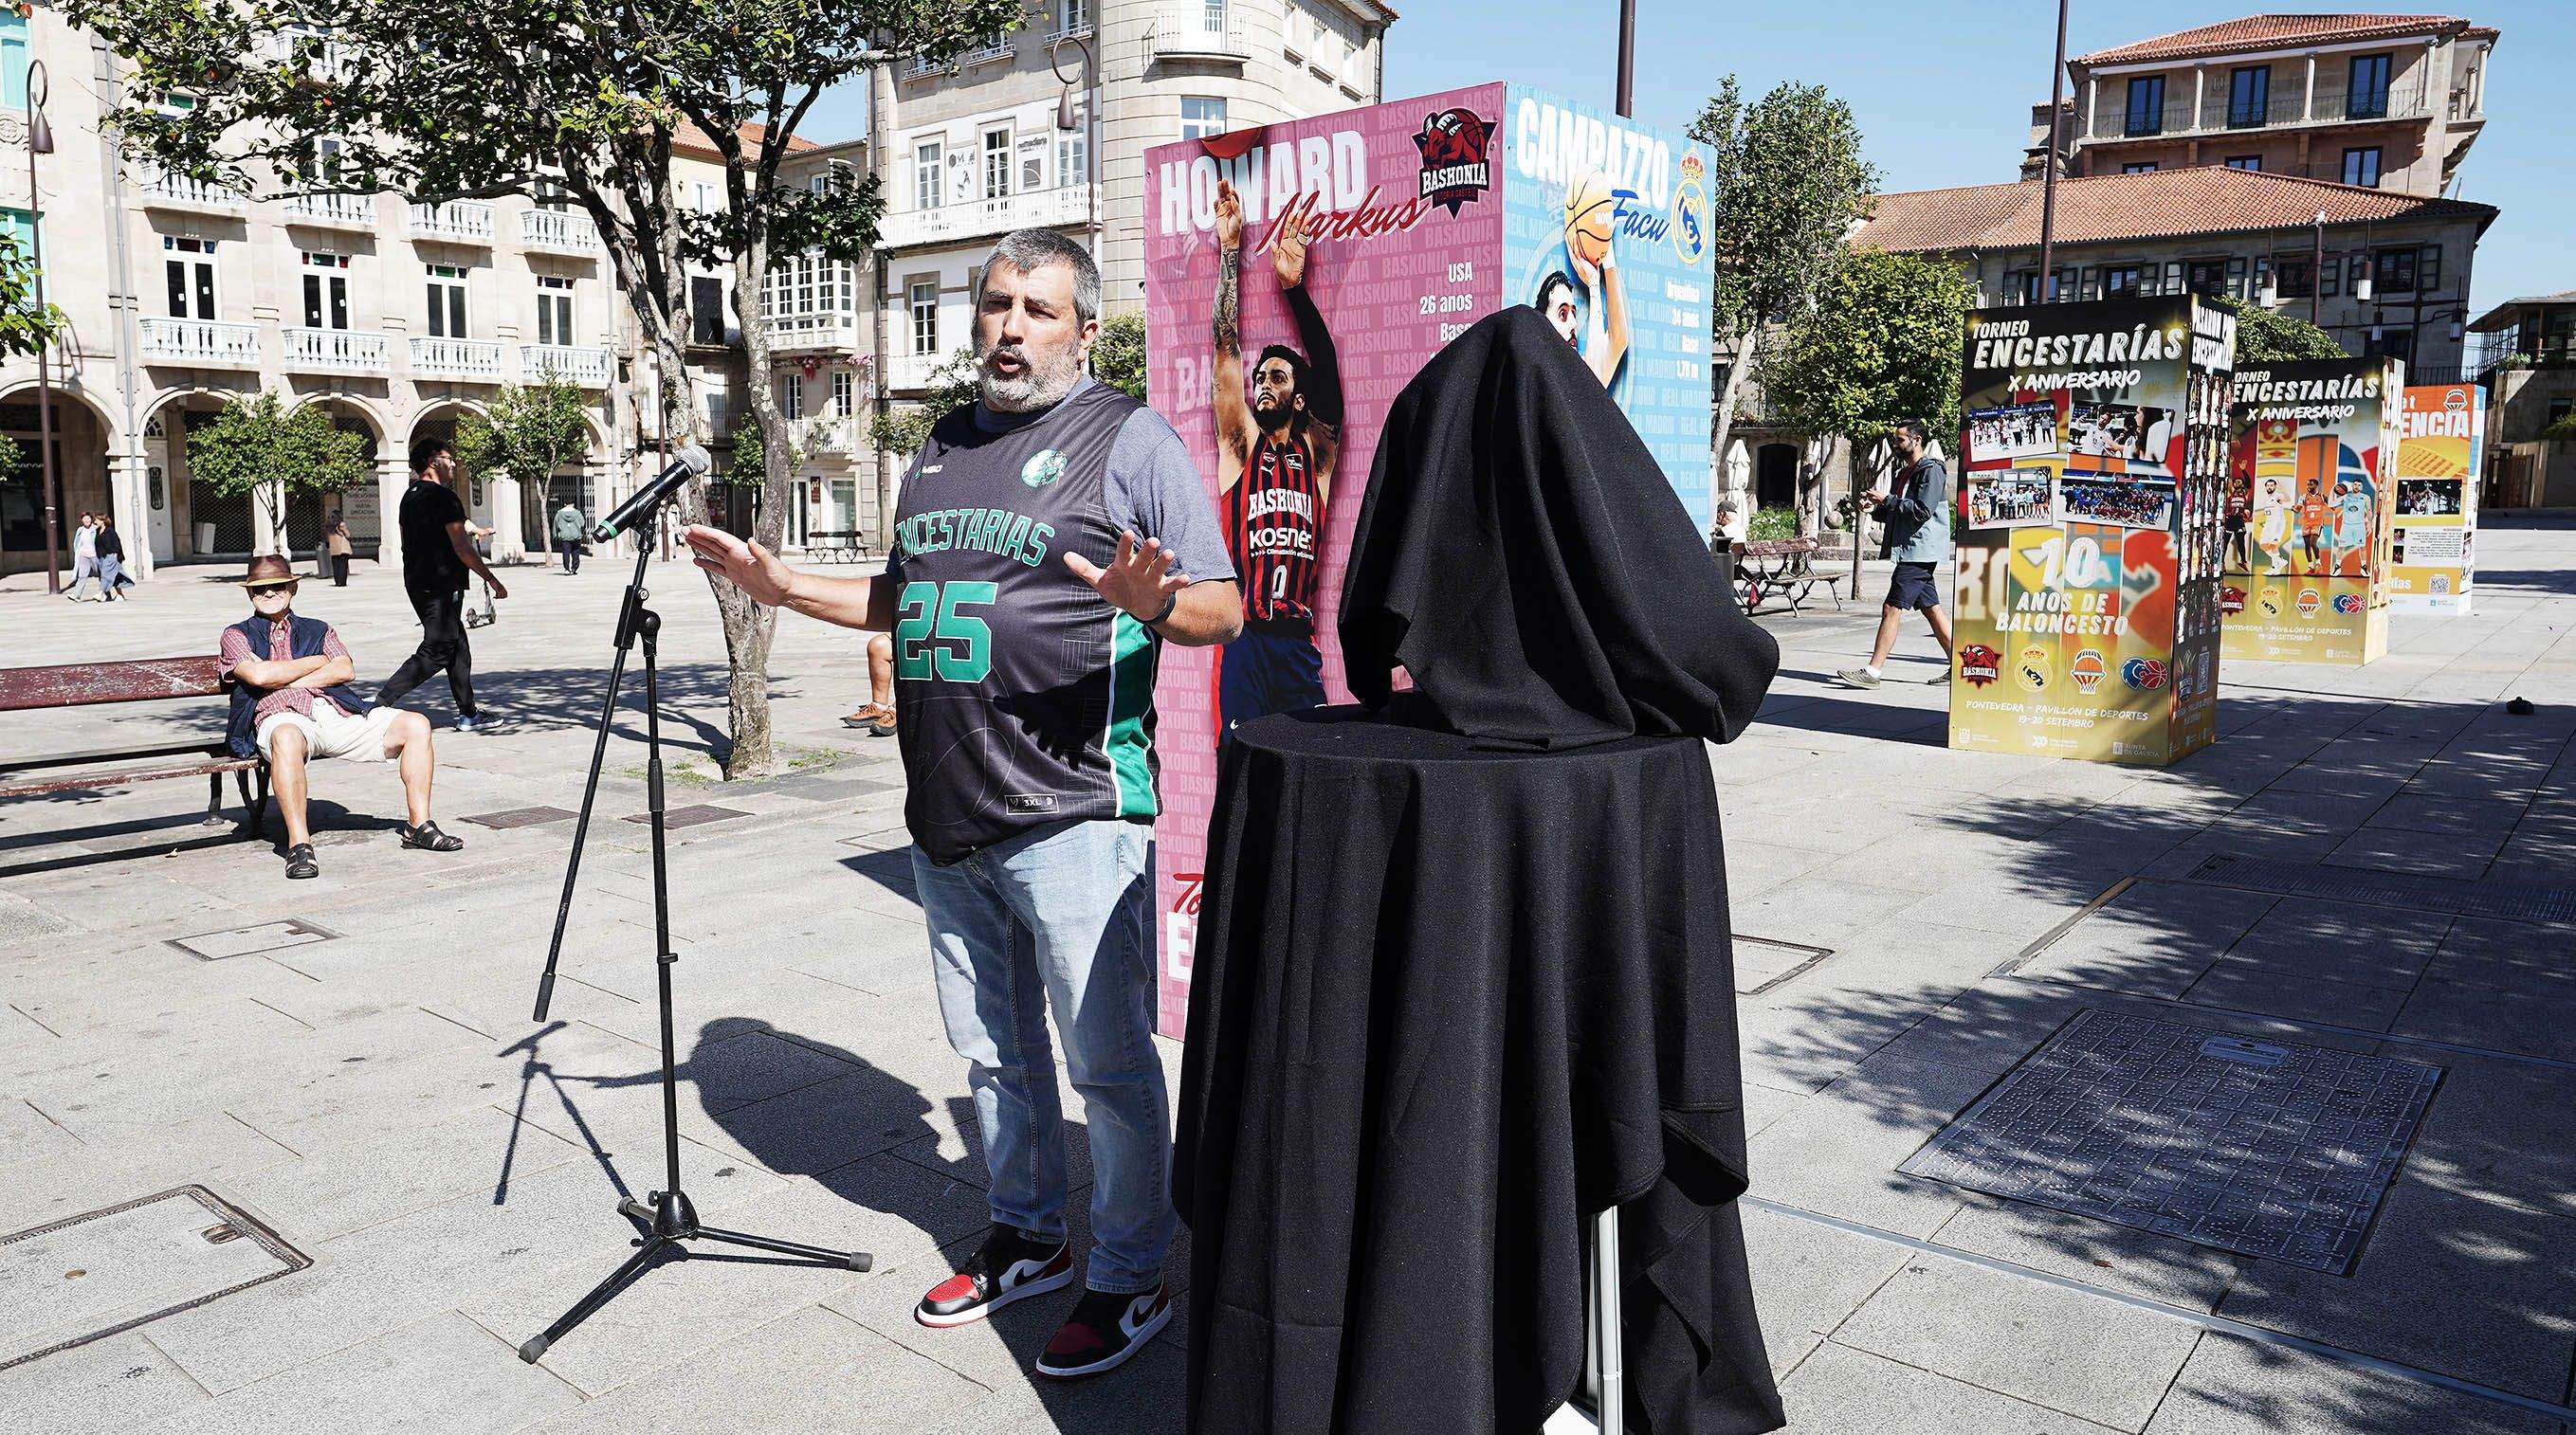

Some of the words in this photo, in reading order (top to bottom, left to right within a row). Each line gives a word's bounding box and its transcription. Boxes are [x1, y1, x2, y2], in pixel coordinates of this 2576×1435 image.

[1517, 97, 1670, 211] CAMPAZZO
[1160, 131, 1365, 236] HOWARD
[1422, 162, 1488, 194] BASKONIA
[1254, 185, 1433, 255] Markus
[1611, 189, 1670, 243] Facu
[1448, 262, 1472, 282] USA
[1419, 296, 1436, 316] 26
[1440, 294, 1472, 313] anos
[1972, 319, 2030, 339] TORNEO
[1973, 323, 2185, 370] ENCESTARÍAS
[2006, 374, 2022, 392] X
[2024, 369, 2142, 392] ANIVERSARIO
[2233, 373, 2380, 404] ENCESTARÍAS
[2234, 371, 2271, 384] ORNEO
[2246, 408, 2259, 422] X
[2260, 405, 2355, 421] ANIVERSARIO
[1248, 487, 1312, 525] BASKONIA
[2040, 536, 2101, 589] 10
[1271, 564, 1288, 599] 0
[2016, 590, 2073, 612] ANOS
[2080, 592, 2110, 613] DE
[897, 580, 998, 684] 25
[1995, 611, 2129, 637] BALONCESTO
[1962, 665, 1997, 679] BASKONIA
[1965, 700, 2025, 714] PONTEVEDRA
[2036, 704, 2082, 716] PAVILLÓN
[2084, 708, 2098, 718] DE
[2100, 709, 2149, 721] DEPORTES
[2046, 717, 2094, 729] SETEMBRO
[1167, 912, 1197, 982] E
